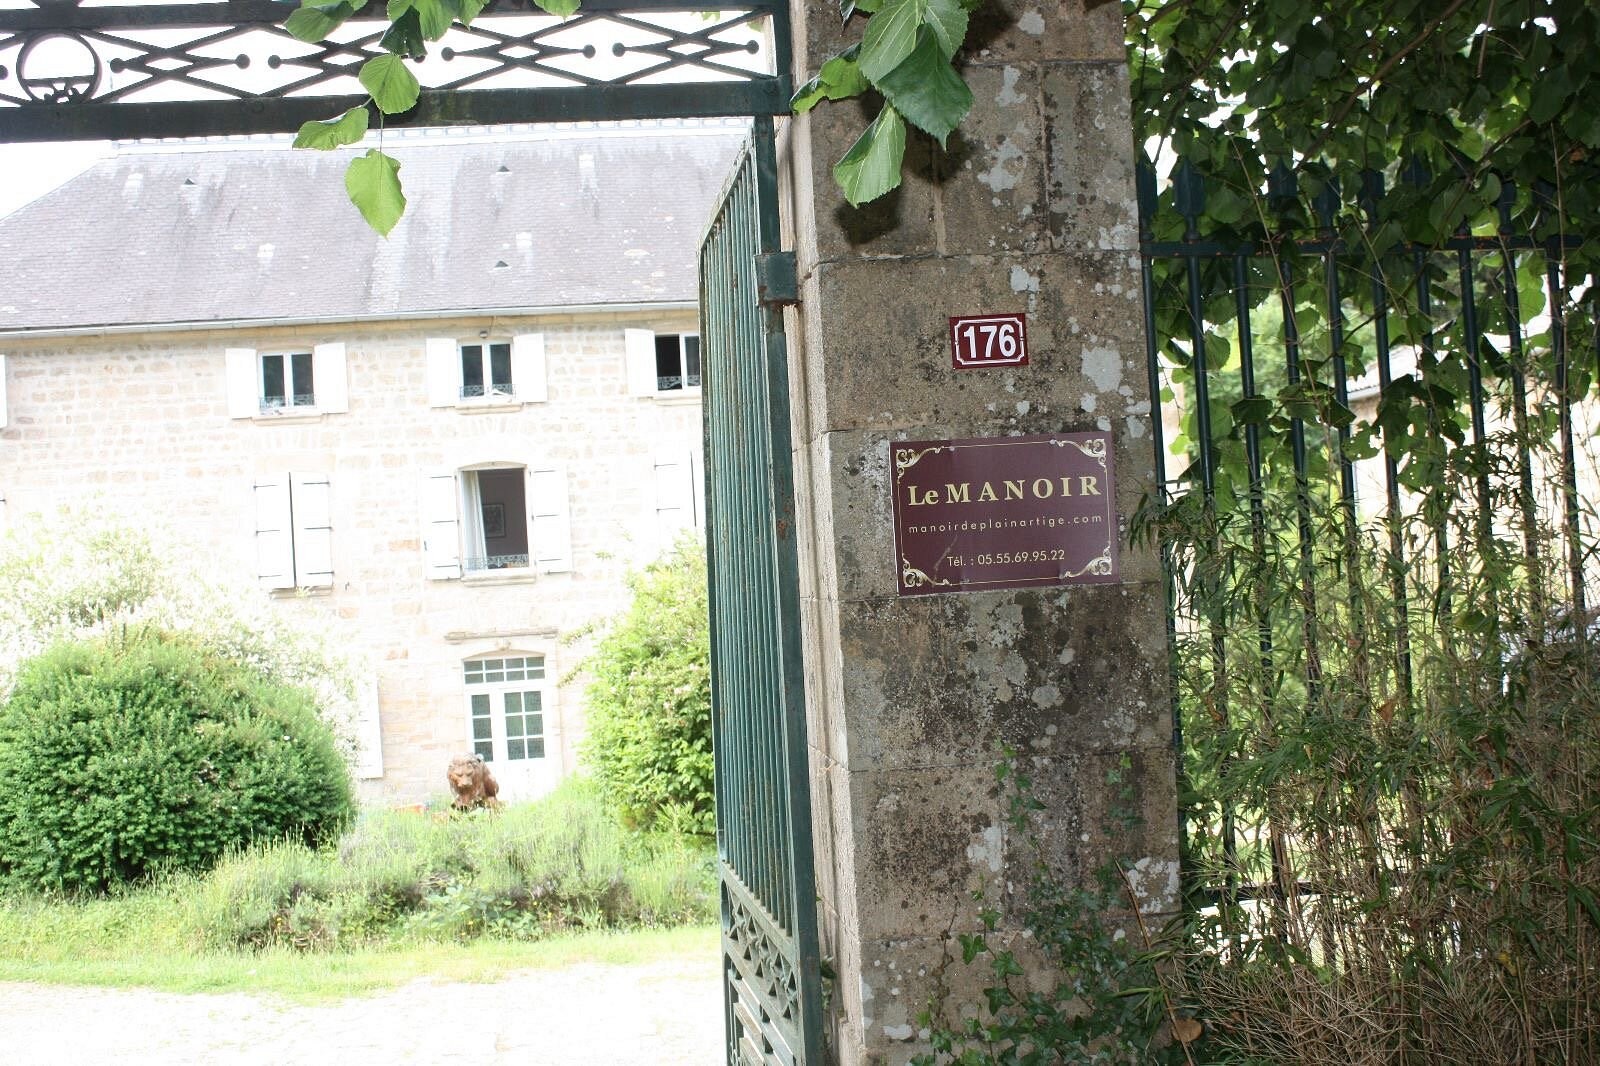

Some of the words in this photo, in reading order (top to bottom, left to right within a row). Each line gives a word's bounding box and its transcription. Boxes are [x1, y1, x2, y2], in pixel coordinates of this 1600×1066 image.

[964, 324, 1016, 358] 176
[908, 485, 939, 506] Le
[945, 476, 1102, 504] MANOIR
[909, 515, 1102, 533] manoirdeplainartige.com
[946, 555, 967, 567] Tél.
[977, 550, 1065, 565] 05.55.69.95.22
